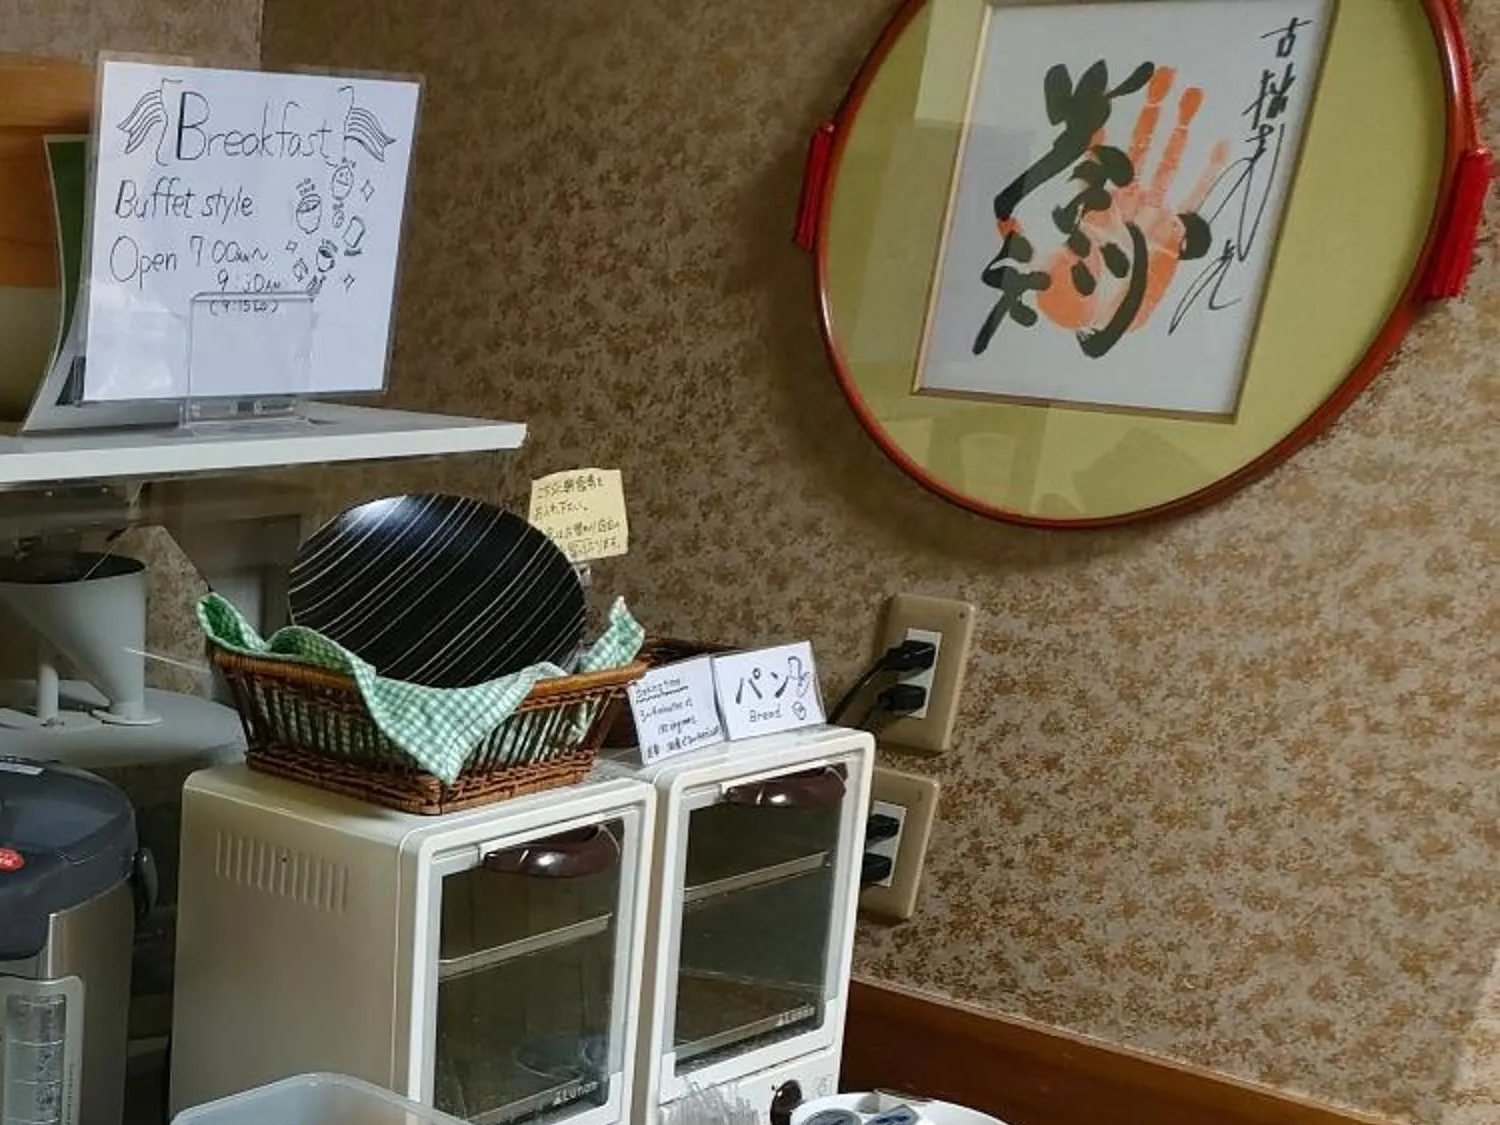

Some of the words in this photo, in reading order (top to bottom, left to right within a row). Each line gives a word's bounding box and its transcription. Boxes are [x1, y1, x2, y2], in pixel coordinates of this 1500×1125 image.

[176, 90, 333, 161] Breakfast
[114, 176, 195, 220] Buffet
[201, 185, 254, 224] style
[109, 235, 178, 291] Open
[735, 667, 789, 704] パン
[749, 703, 783, 722] Bread
